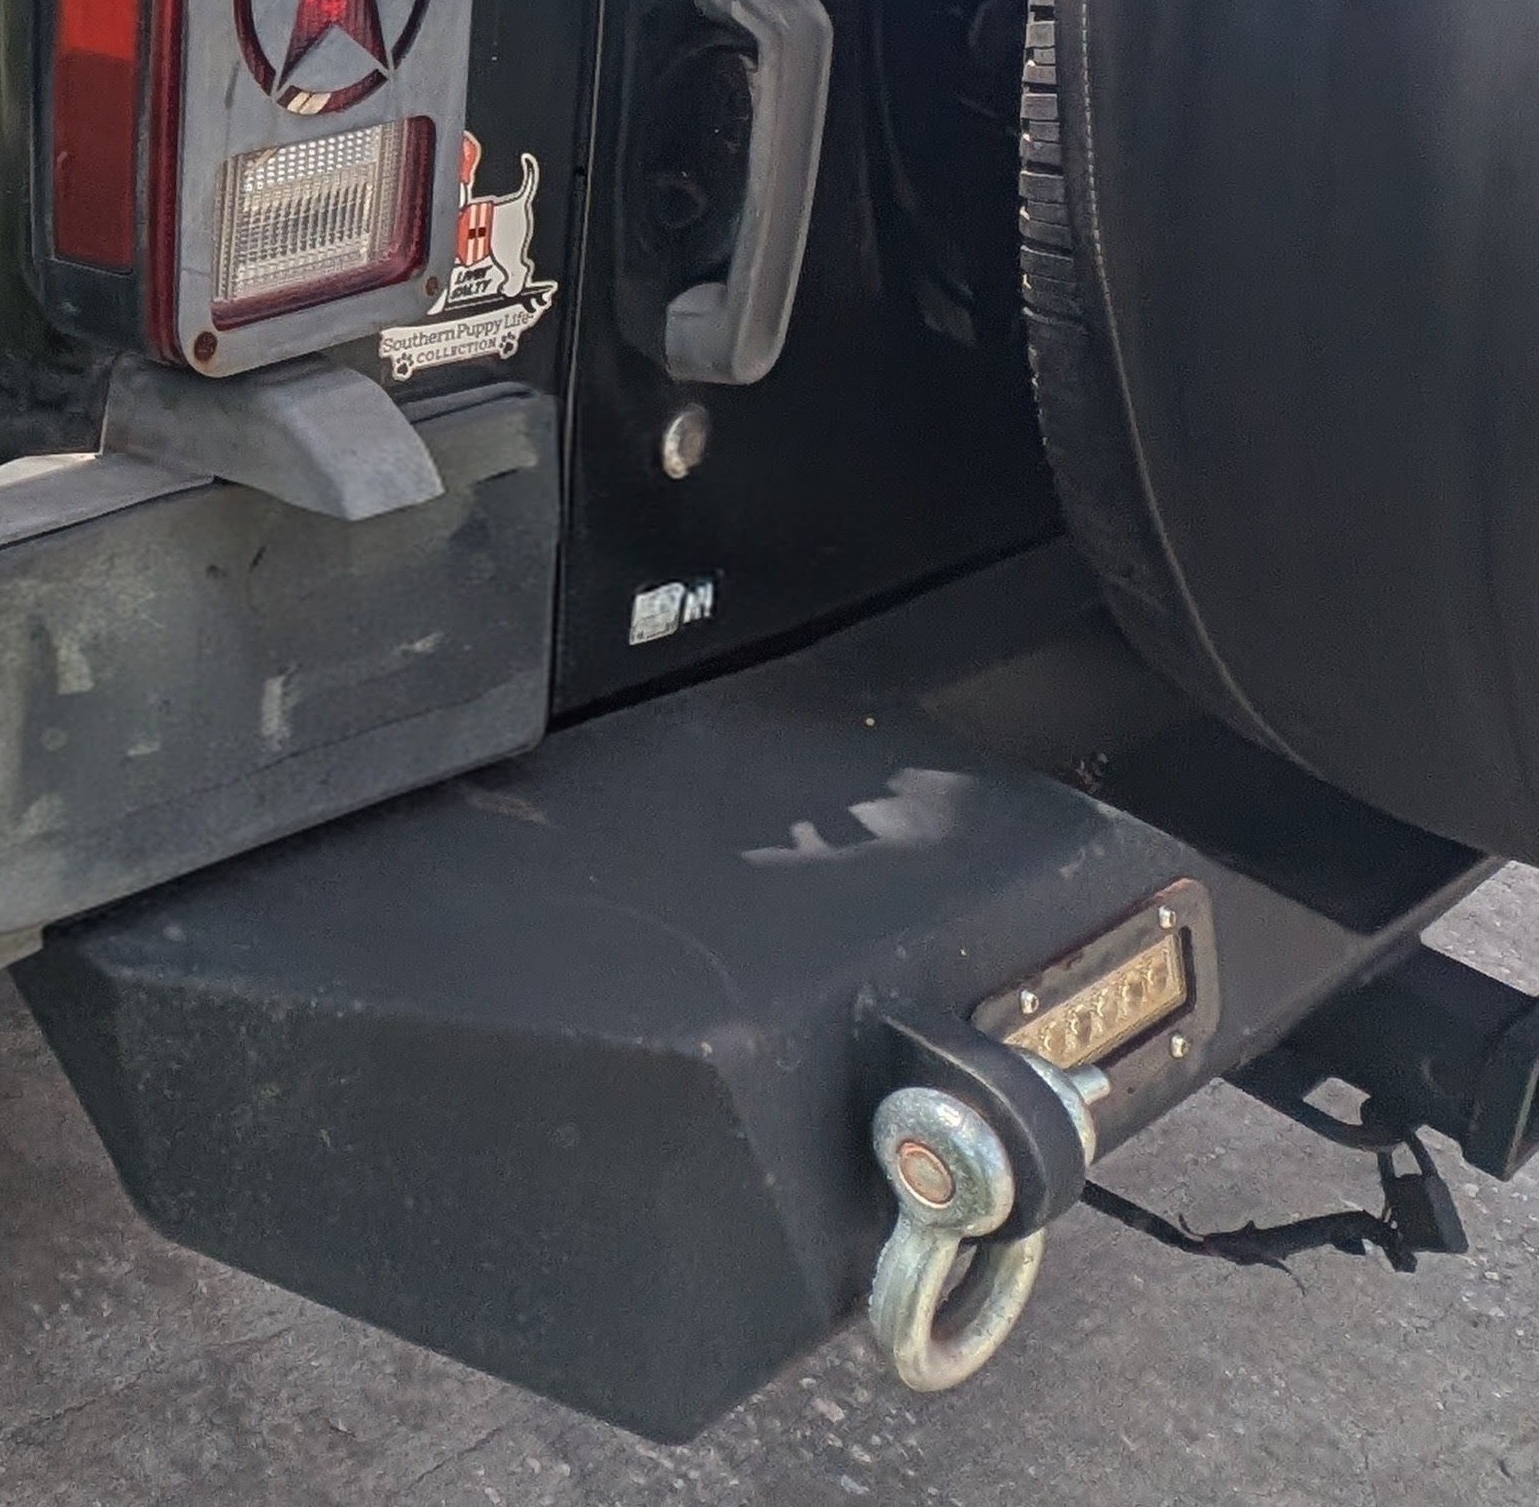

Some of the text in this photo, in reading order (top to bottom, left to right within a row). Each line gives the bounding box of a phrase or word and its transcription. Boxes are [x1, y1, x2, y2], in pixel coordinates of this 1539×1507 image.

[383, 311, 530, 353] Southern Puppy Life
[416, 337, 497, 364] COLLECTION
